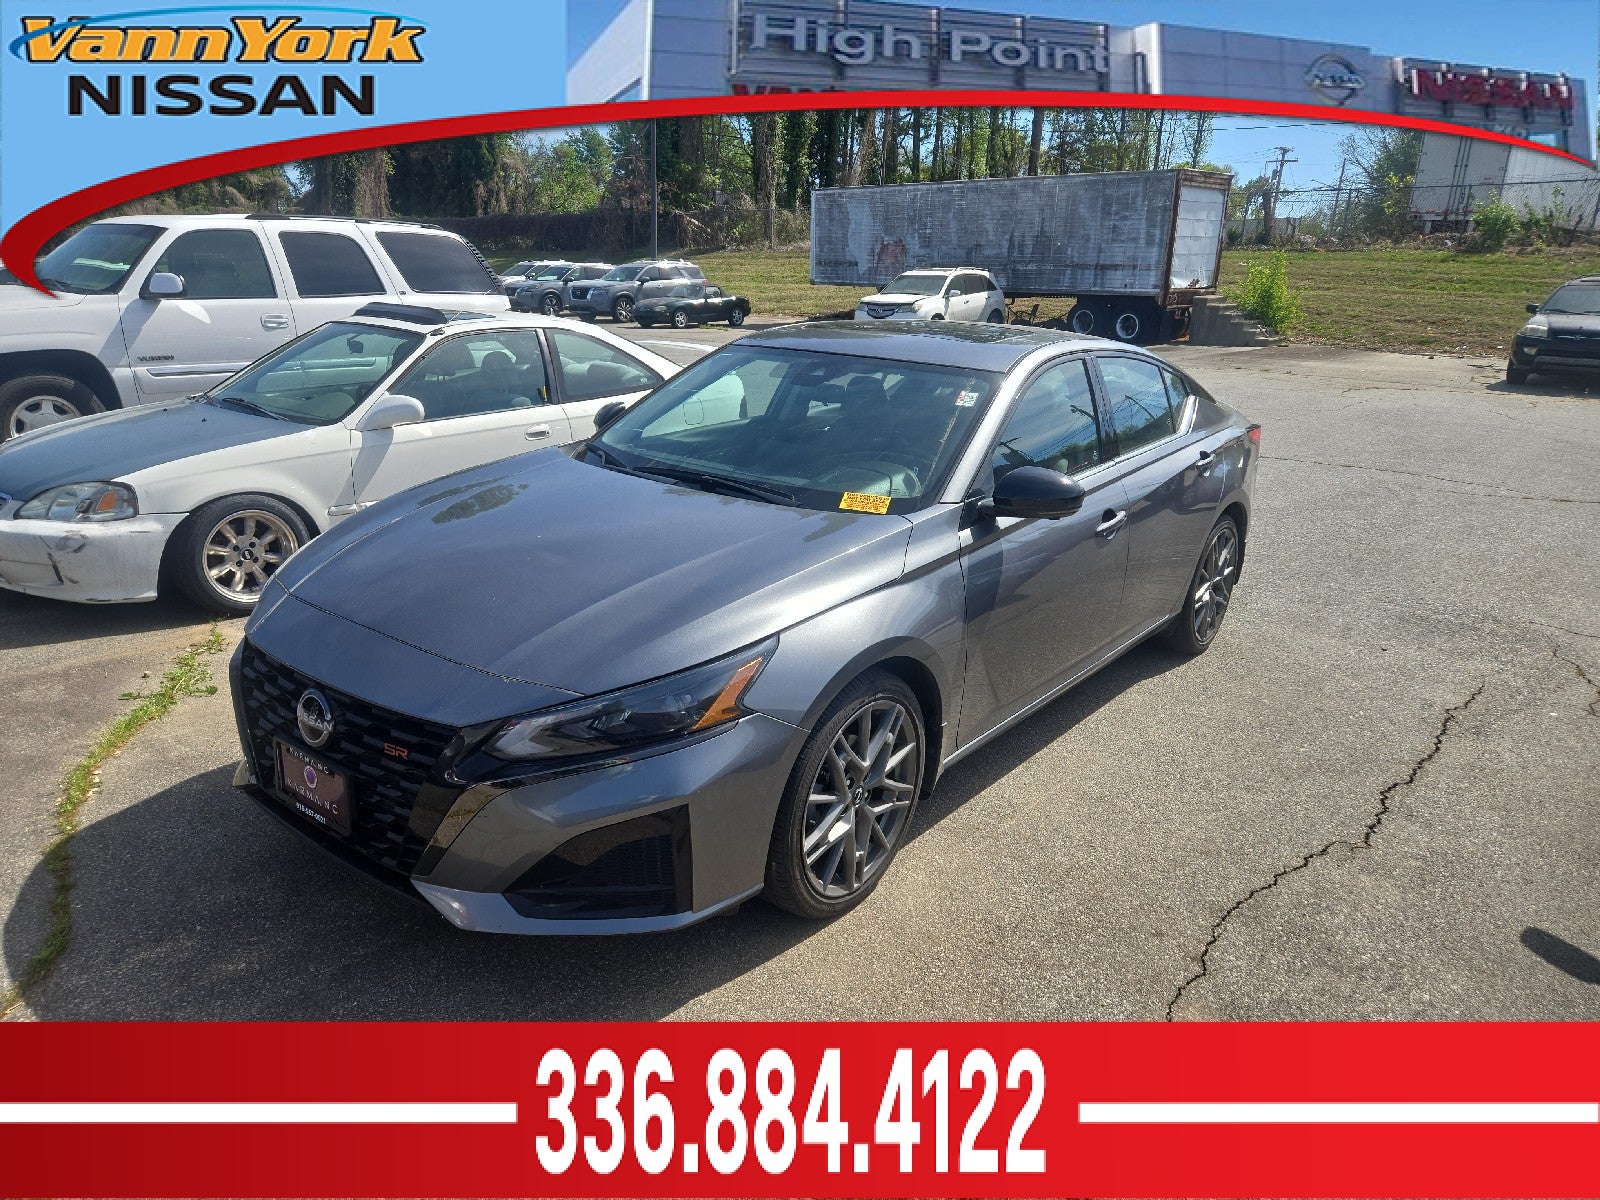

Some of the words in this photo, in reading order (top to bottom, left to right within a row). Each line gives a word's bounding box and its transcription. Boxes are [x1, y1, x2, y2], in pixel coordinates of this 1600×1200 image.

[751, 13, 922, 65] High
[951, 30, 1109, 72] Point
[384, 743, 408, 759] SR
